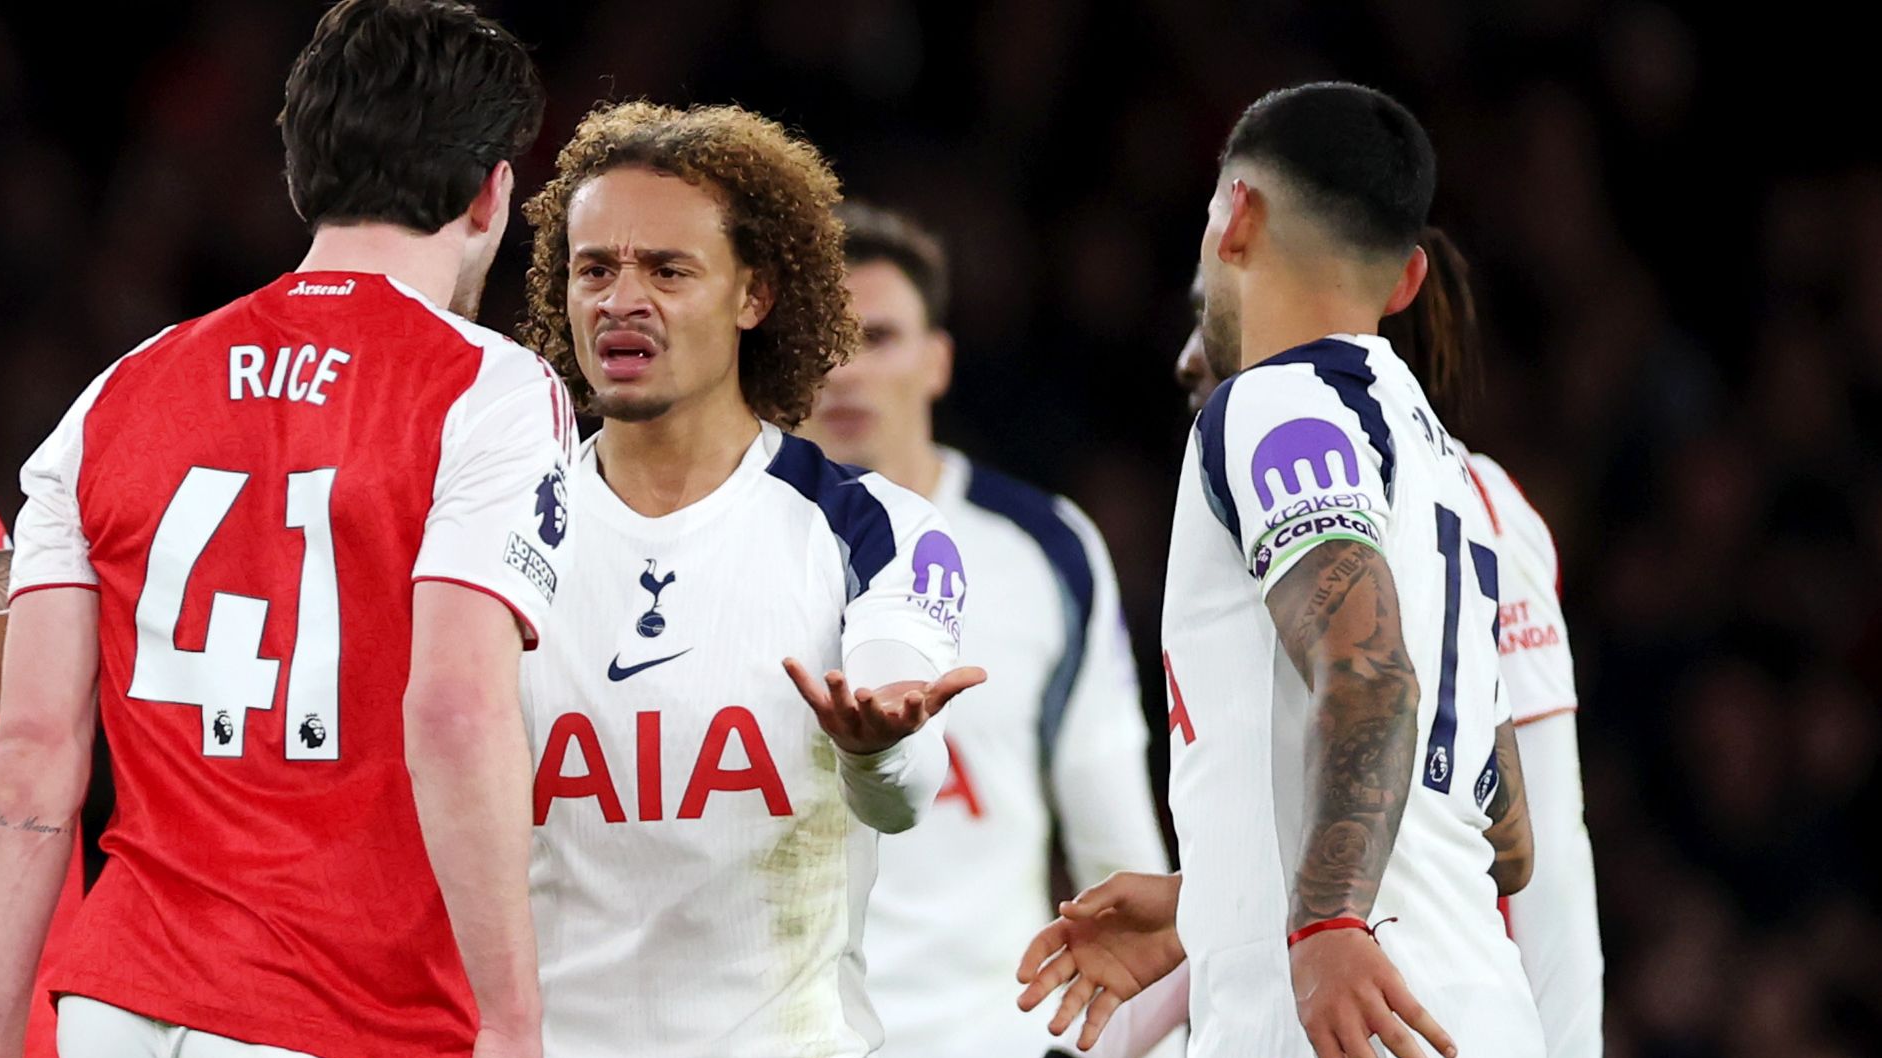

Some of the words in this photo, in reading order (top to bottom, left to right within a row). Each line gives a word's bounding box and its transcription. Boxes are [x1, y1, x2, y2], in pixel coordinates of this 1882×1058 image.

[228, 343, 351, 406] RICE
[1265, 493, 1372, 530] kraken
[126, 465, 341, 761] 41
[532, 705, 794, 827] AIA
